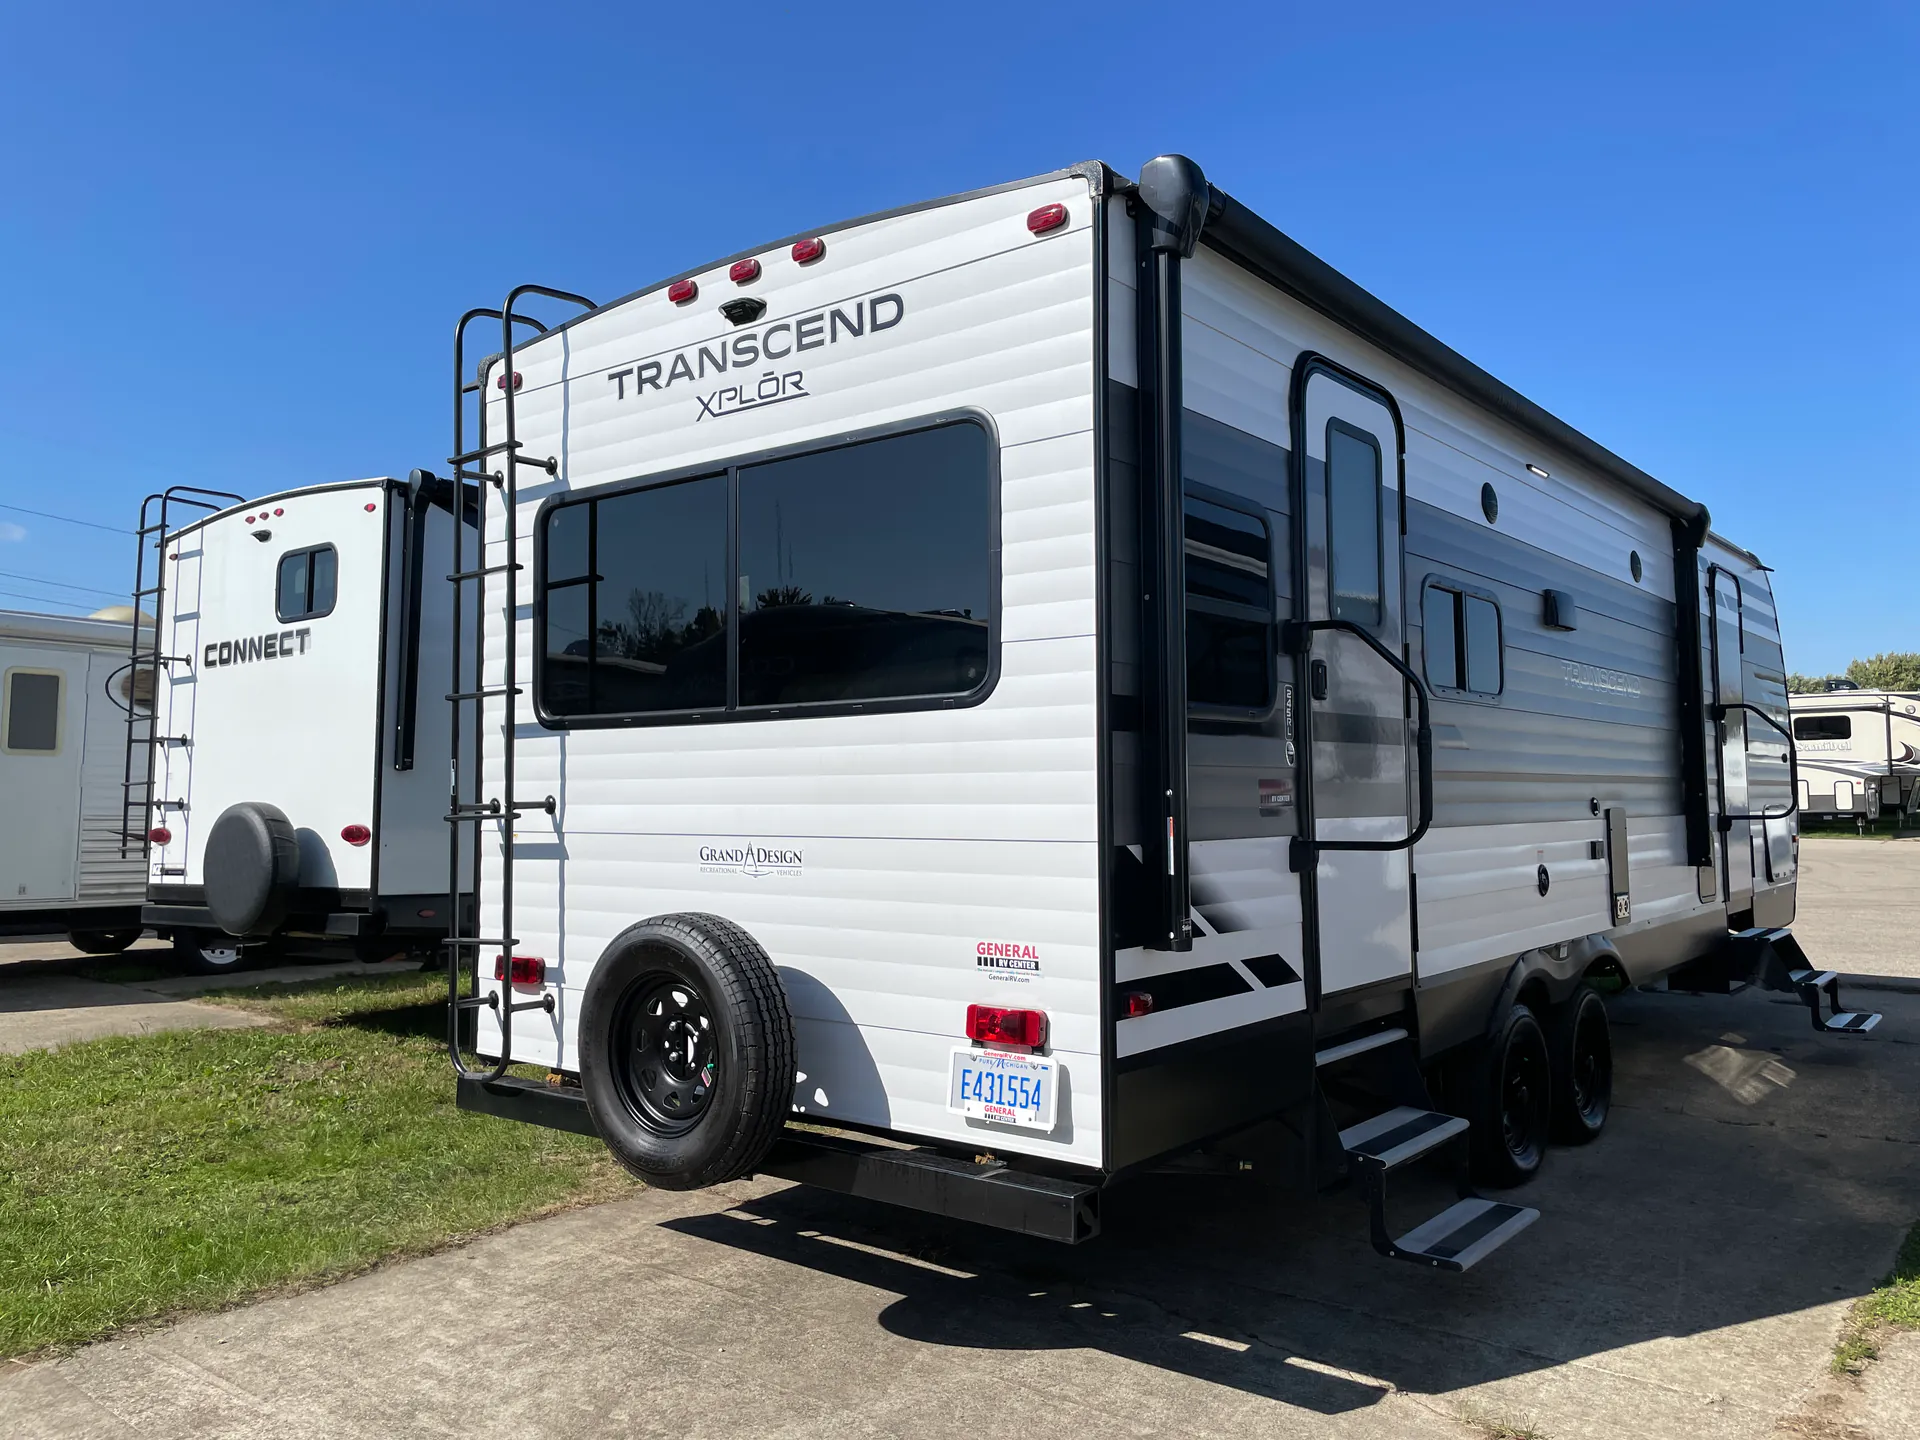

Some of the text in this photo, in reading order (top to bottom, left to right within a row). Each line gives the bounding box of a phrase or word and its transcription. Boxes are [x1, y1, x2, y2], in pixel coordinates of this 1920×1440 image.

[607, 293, 905, 401] TRANSCEND
[204, 627, 312, 669] CONNECT
[1795, 740, 1852, 752] Sanibel
[699, 845, 802, 863] GRAND DESIGN
[700, 866, 738, 874] RECREATIONAL
[976, 941, 1039, 959] GENERAL
[998, 959, 1036, 969] RV CENTER
[988, 974, 1030, 983] GeneralRV.com
[983, 1050, 1027, 1061] GeneralRV.com
[961, 1069, 1041, 1111] E431554
[984, 1104, 1016, 1117] GENERAL
